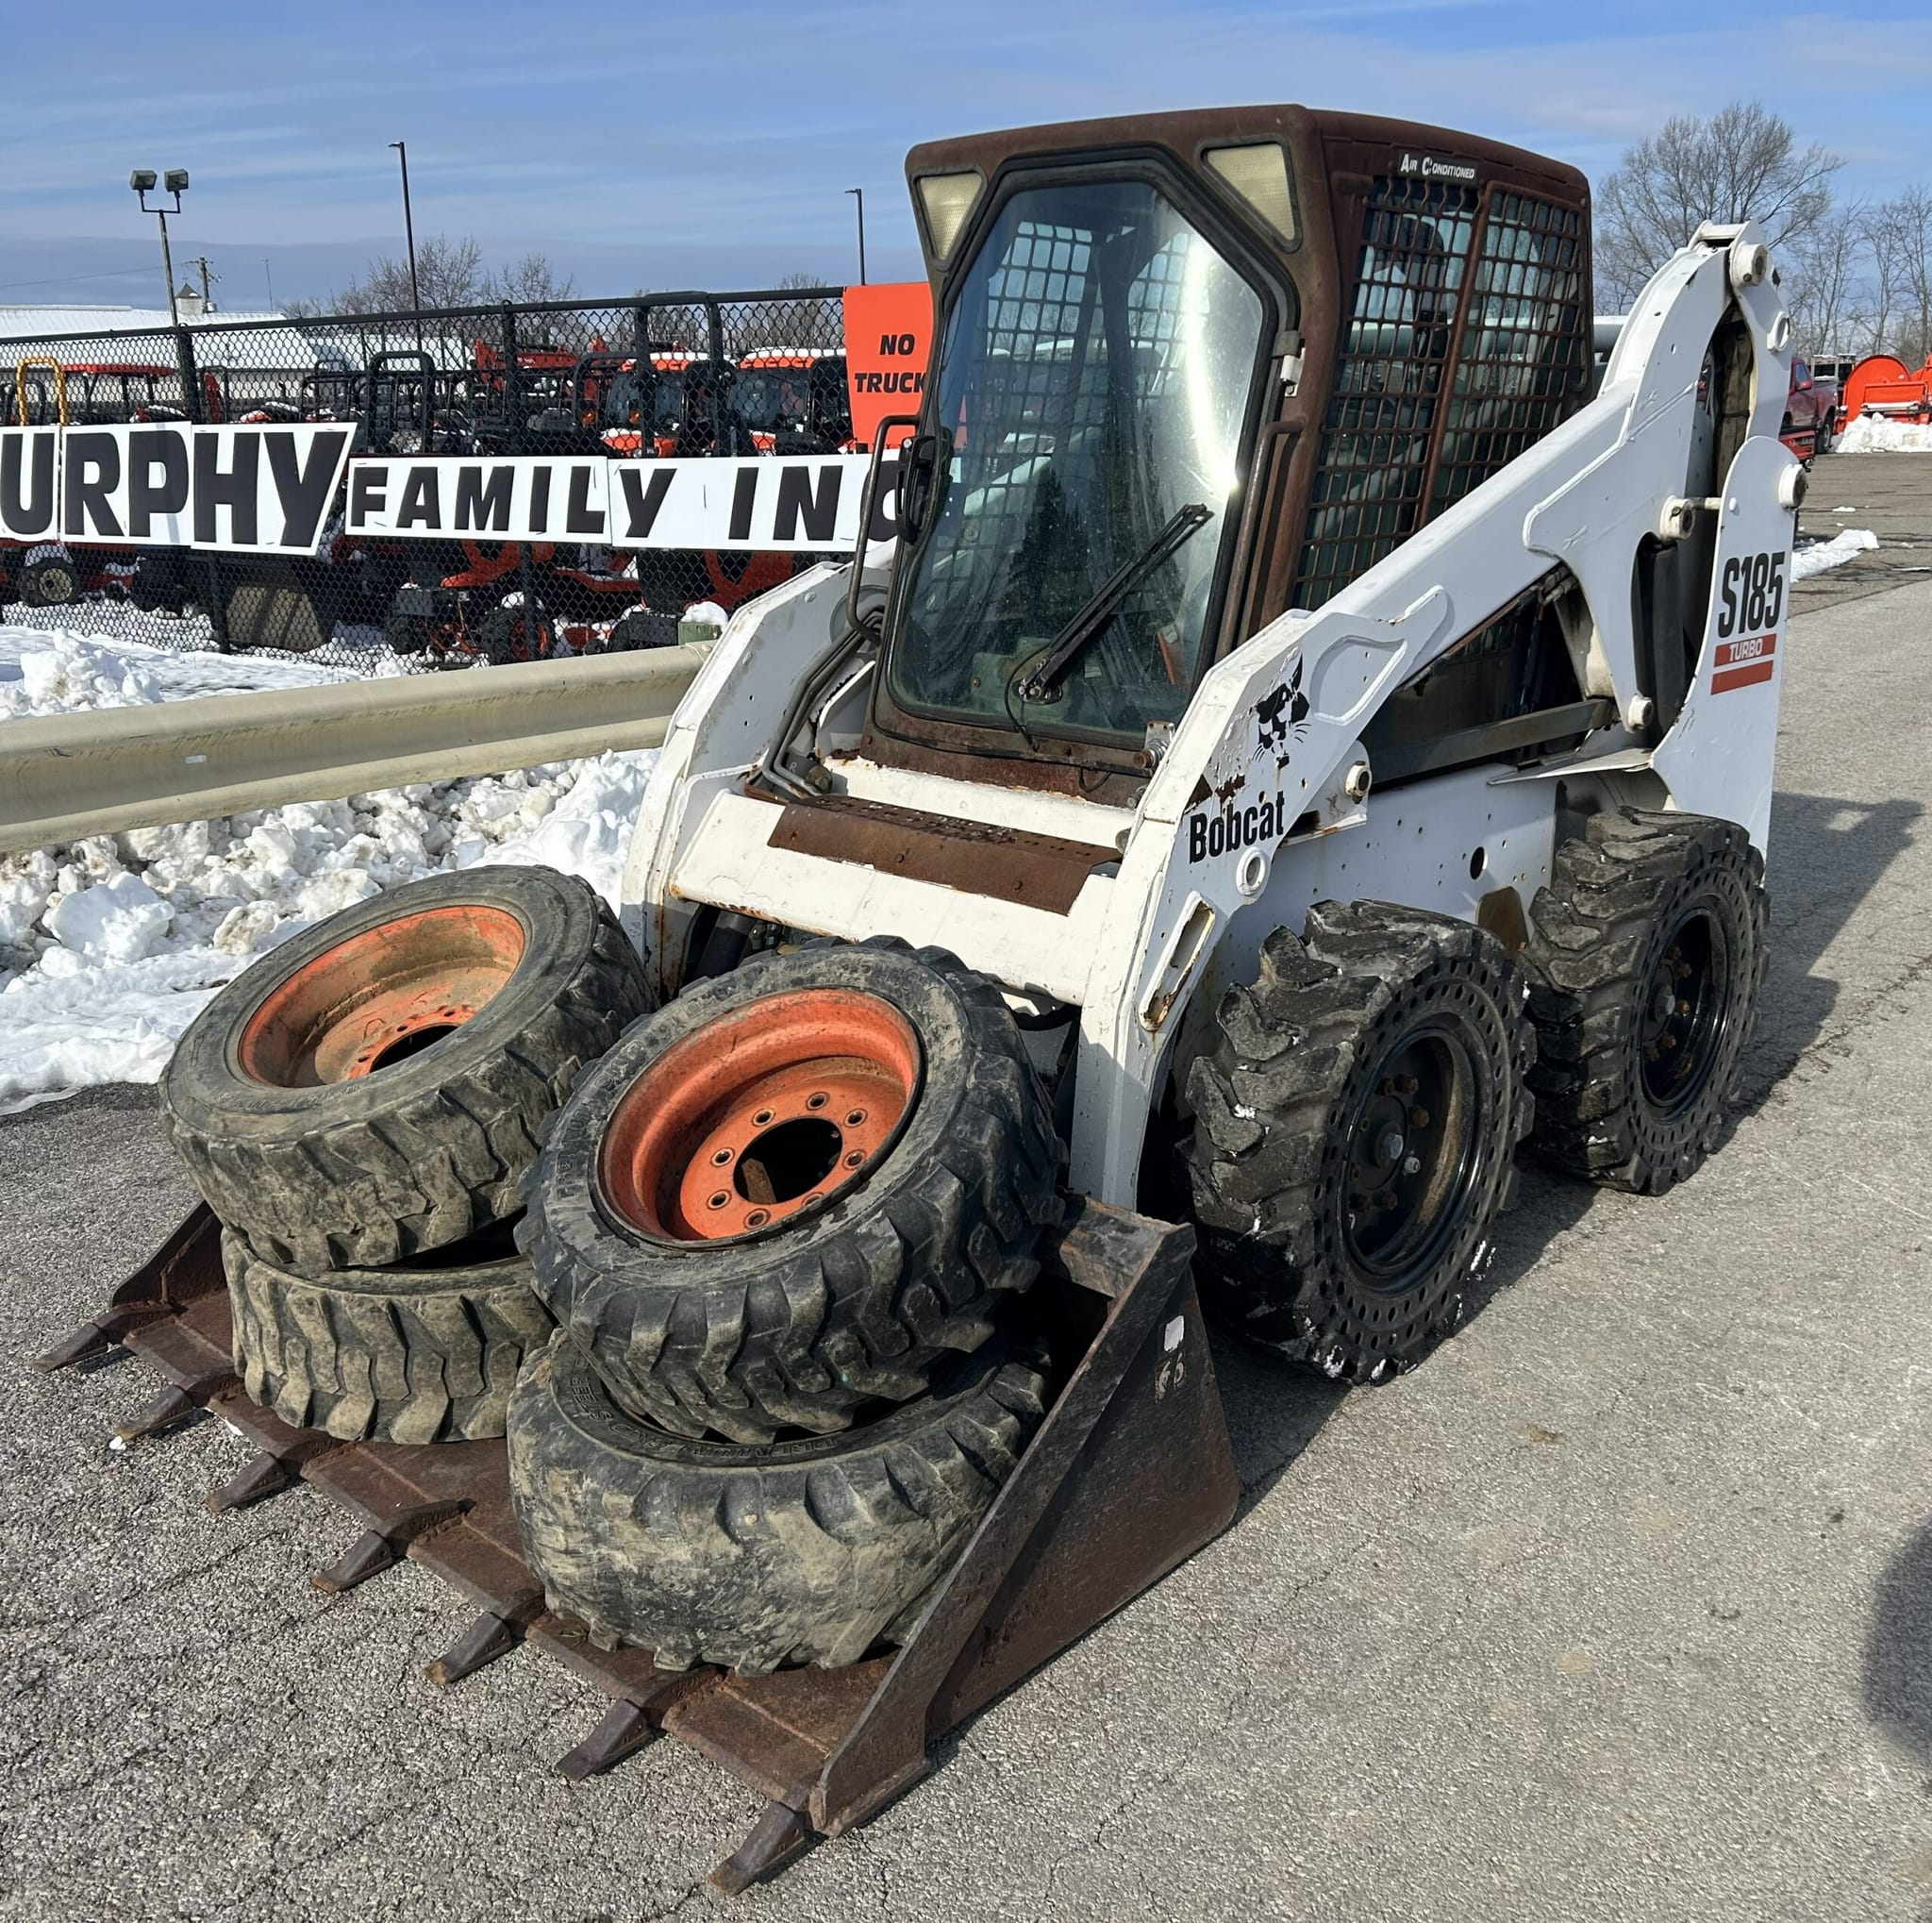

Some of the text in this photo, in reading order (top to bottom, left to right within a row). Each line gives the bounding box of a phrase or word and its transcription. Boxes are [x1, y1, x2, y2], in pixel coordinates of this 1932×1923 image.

[879, 334, 915, 356] NO
[350, 465, 677, 538] FAMILY
[1718, 551, 1786, 638] S185
[1729, 638, 1764, 662] TURBO
[1190, 790, 1285, 864] Bobcat
